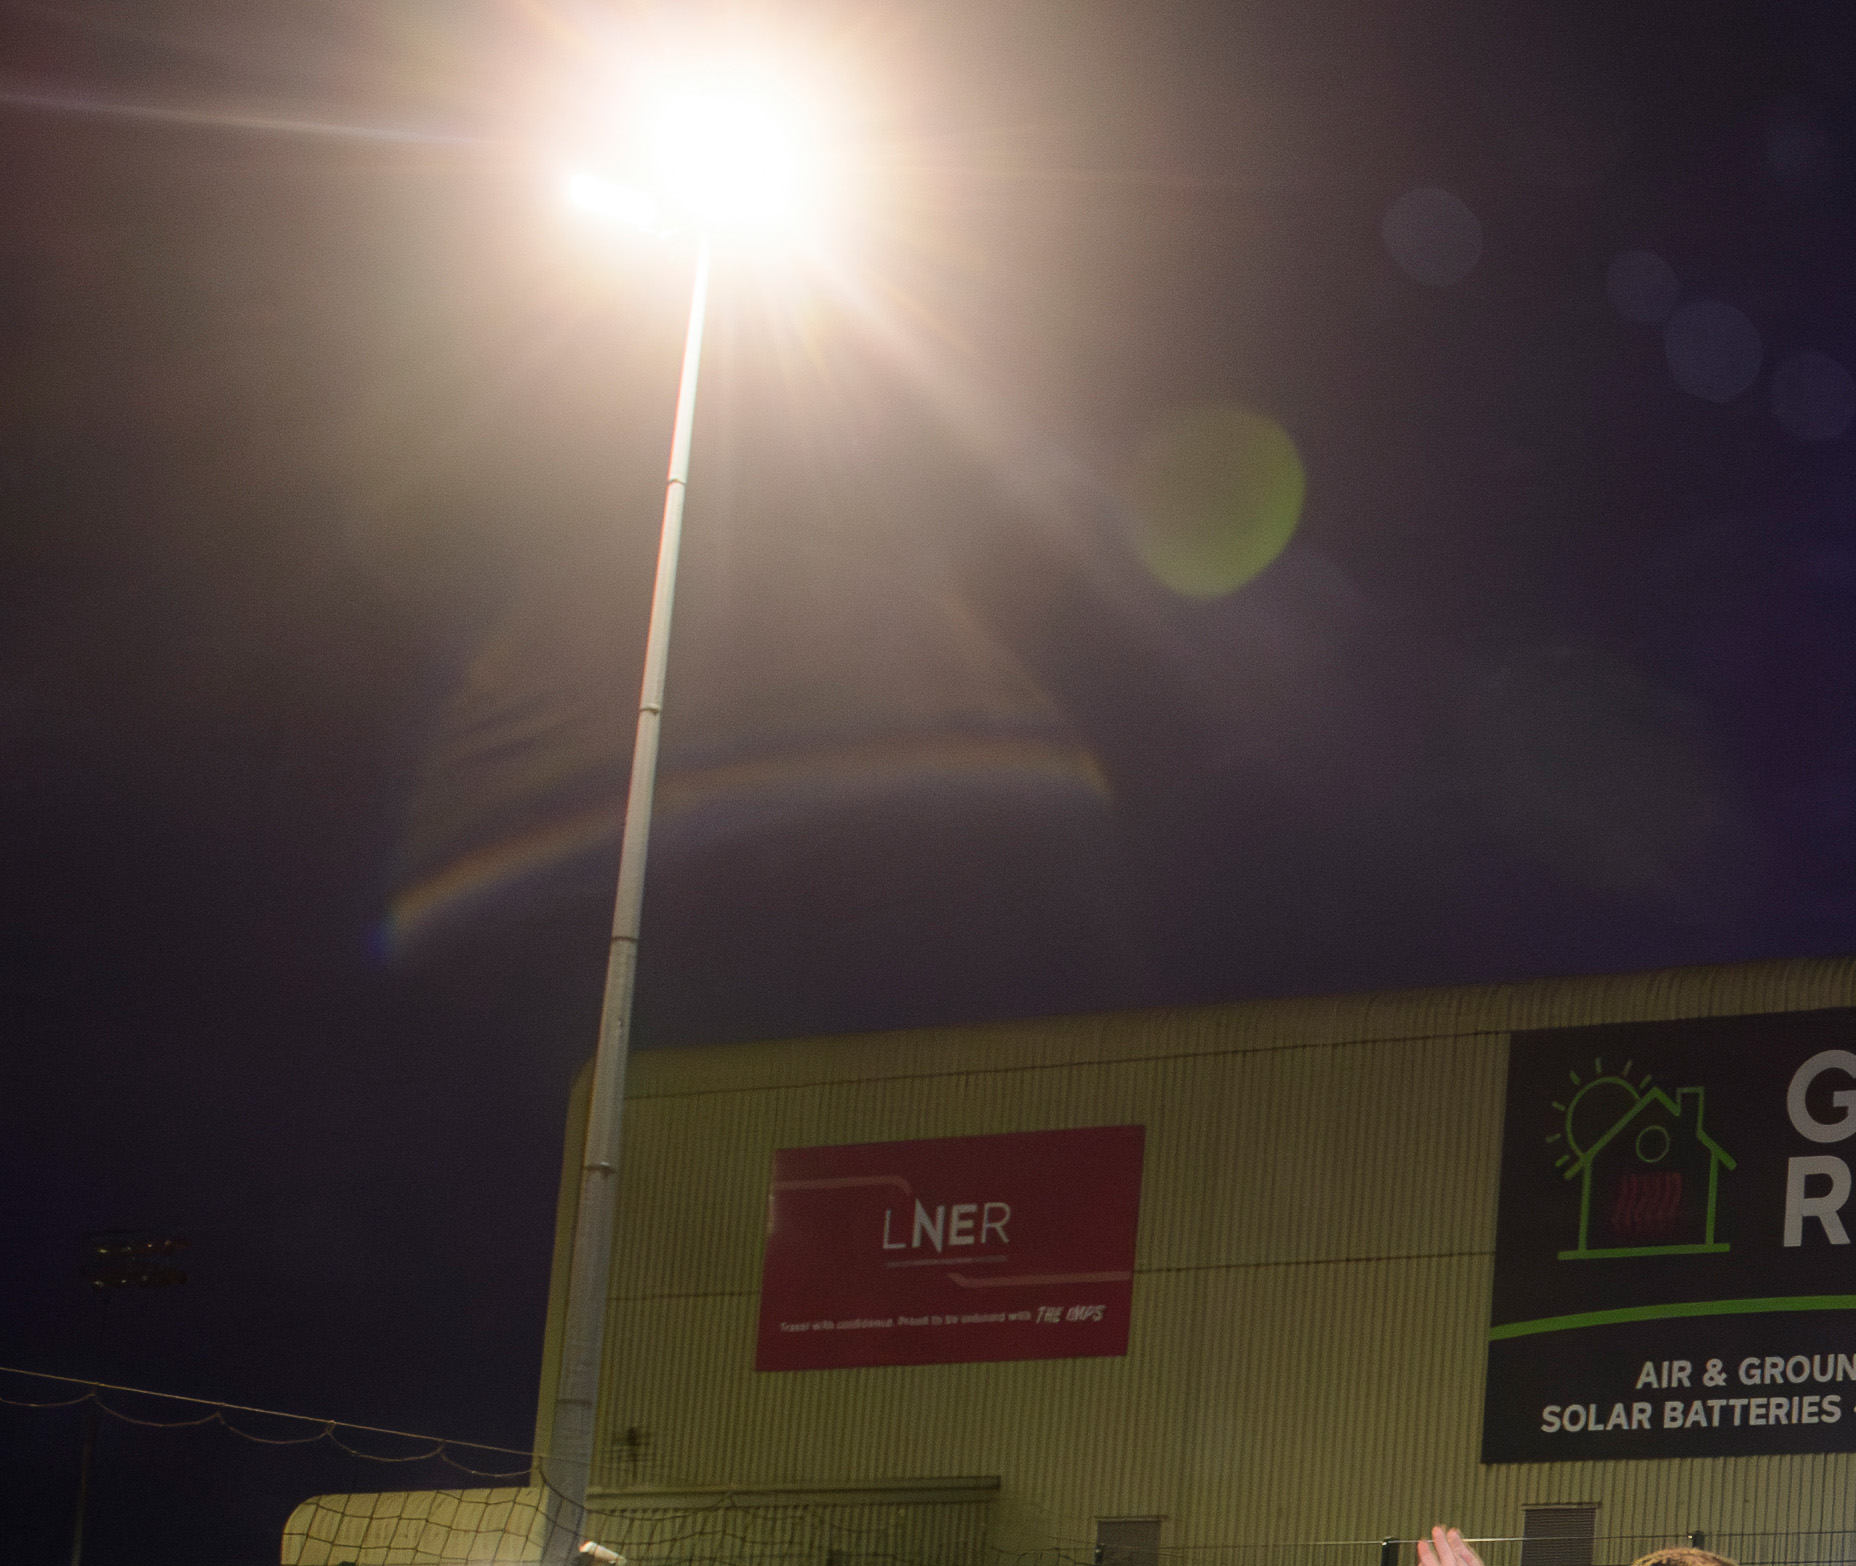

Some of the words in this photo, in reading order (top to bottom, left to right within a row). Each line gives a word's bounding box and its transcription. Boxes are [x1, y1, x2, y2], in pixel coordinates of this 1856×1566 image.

[882, 1199, 1011, 1253] LNER
[1636, 1359, 1694, 1389] AIR
[1702, 1358, 1728, 1387] &
[1541, 1401, 1653, 1433] SOLAR
[1663, 1393, 1842, 1429] BATTERIES
